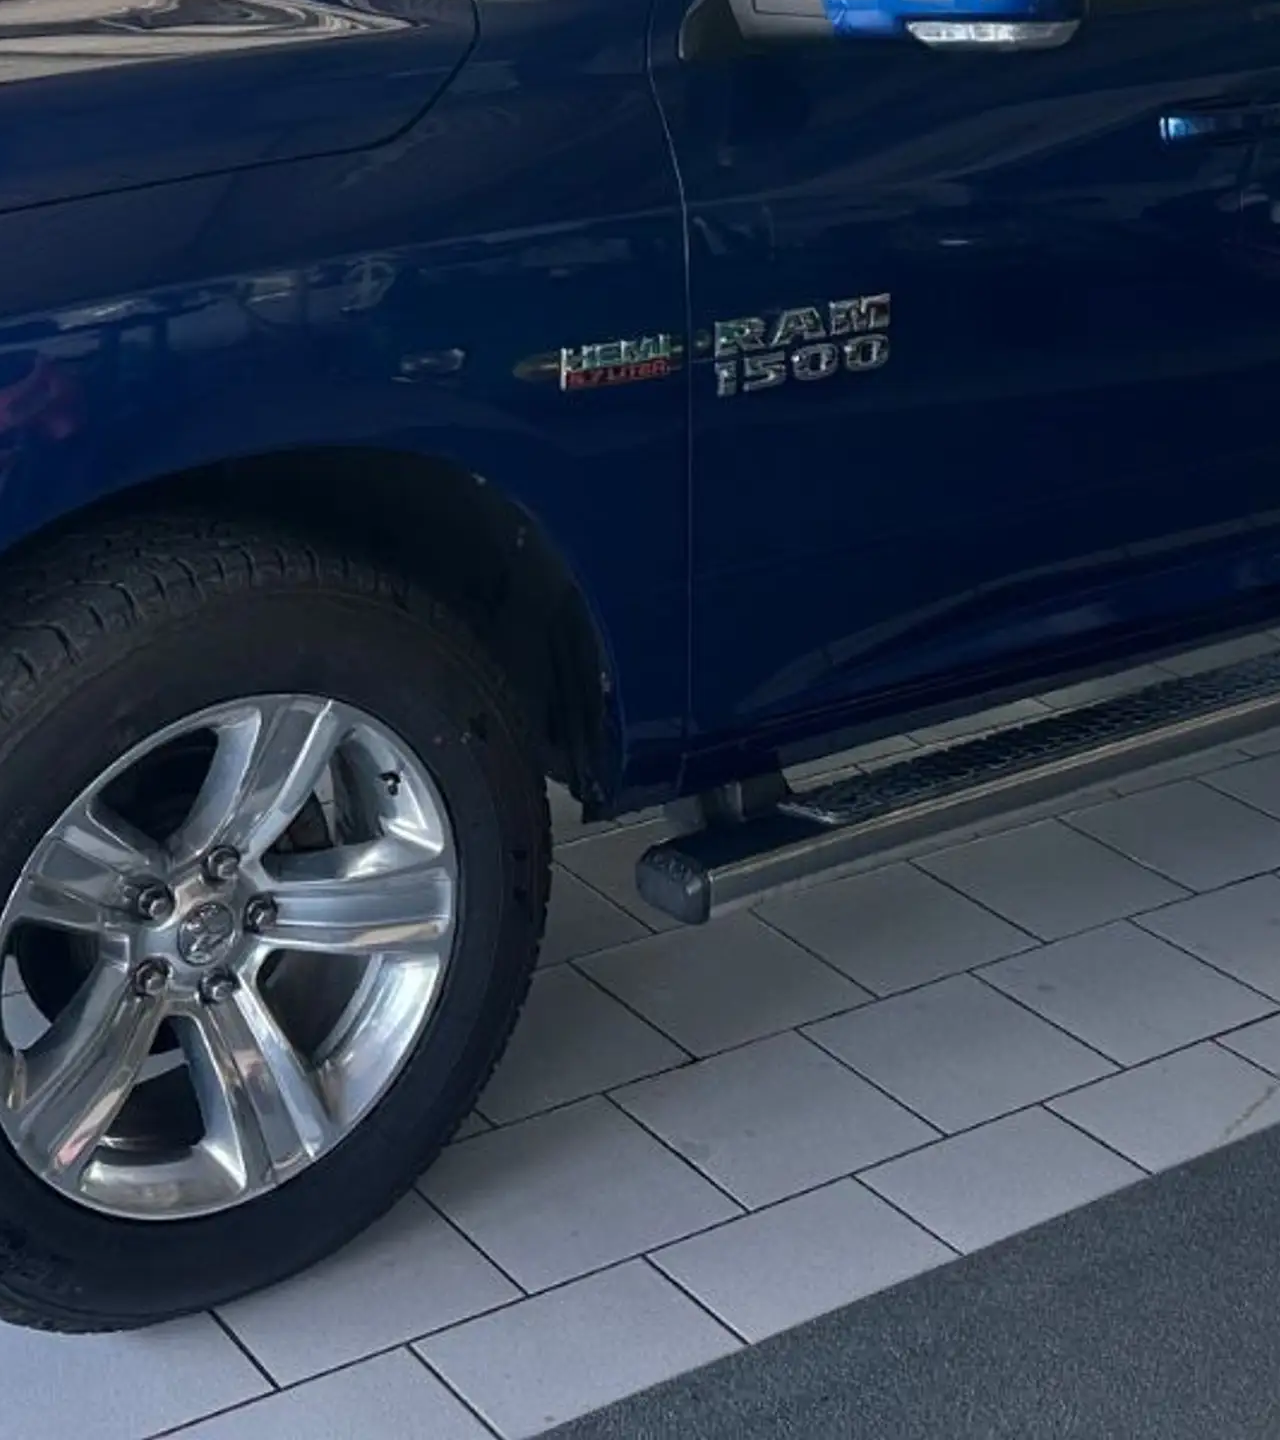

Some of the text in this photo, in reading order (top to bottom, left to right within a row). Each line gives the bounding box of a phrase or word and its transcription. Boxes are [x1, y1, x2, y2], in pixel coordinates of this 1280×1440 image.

[560, 333, 674, 380] HEMI
[714, 293, 891, 357] RAM
[714, 334, 891, 398] 1500
